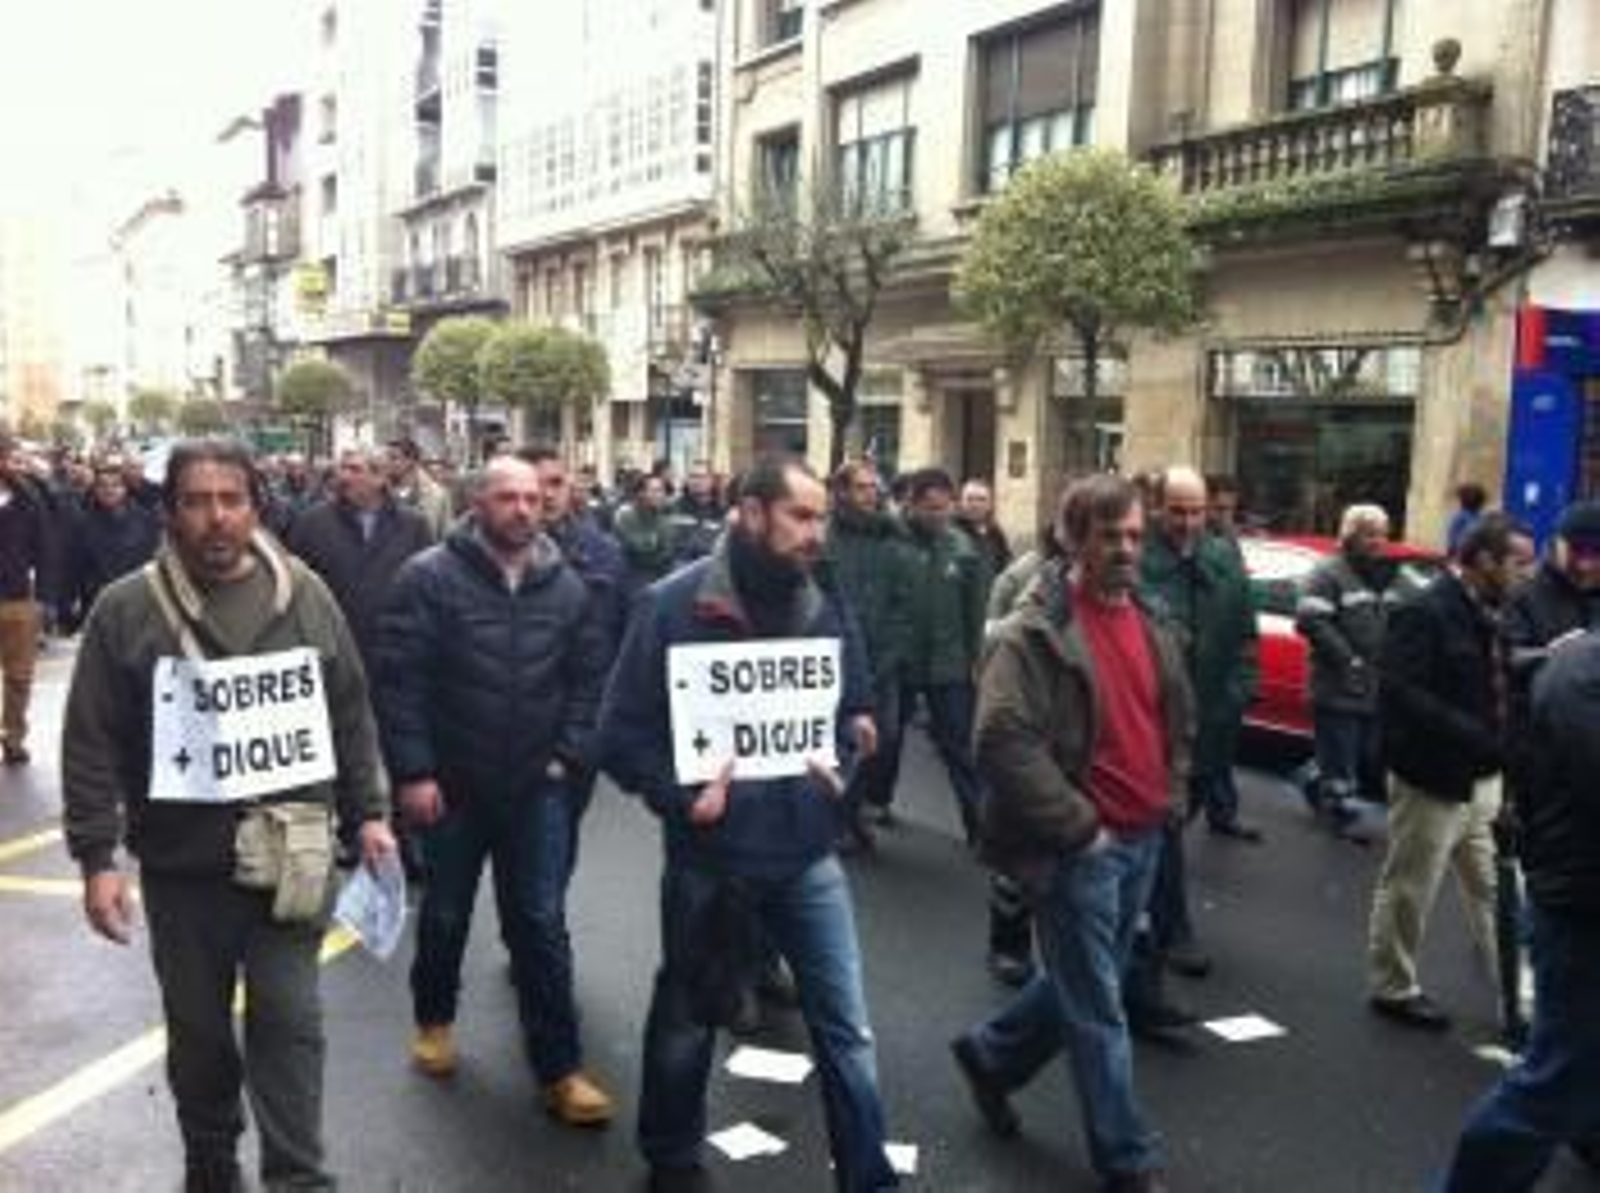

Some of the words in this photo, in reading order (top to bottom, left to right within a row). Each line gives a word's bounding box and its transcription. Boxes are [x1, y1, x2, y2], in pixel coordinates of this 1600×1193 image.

[193, 664, 315, 712] SOBRES
[710, 656, 836, 694] SOBRES
[173, 747, 192, 775] +
[212, 728, 317, 780] DIQUE
[692, 729, 711, 757] +
[734, 717, 828, 758] DIQUE
